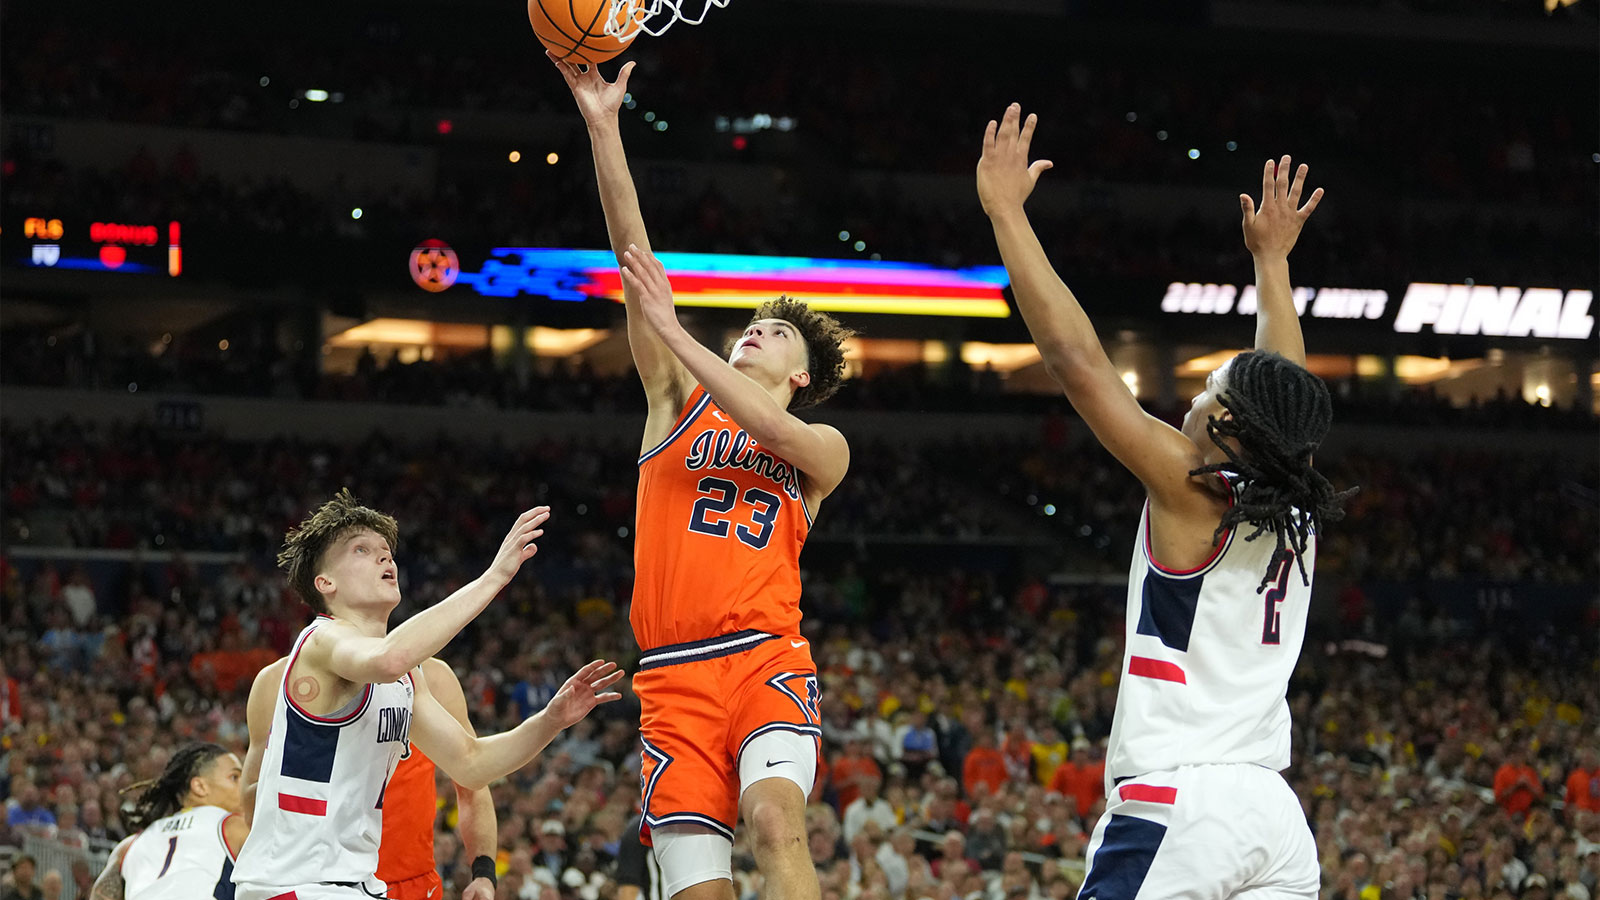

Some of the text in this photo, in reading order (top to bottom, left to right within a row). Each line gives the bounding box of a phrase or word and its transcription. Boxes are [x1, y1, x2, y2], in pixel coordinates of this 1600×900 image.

[1161, 282, 1237, 314] 2026
[1393, 282, 1595, 339] FINAL
[688, 476, 782, 550] 23
[1262, 549, 1295, 645] 2
[157, 836, 178, 879] 1
